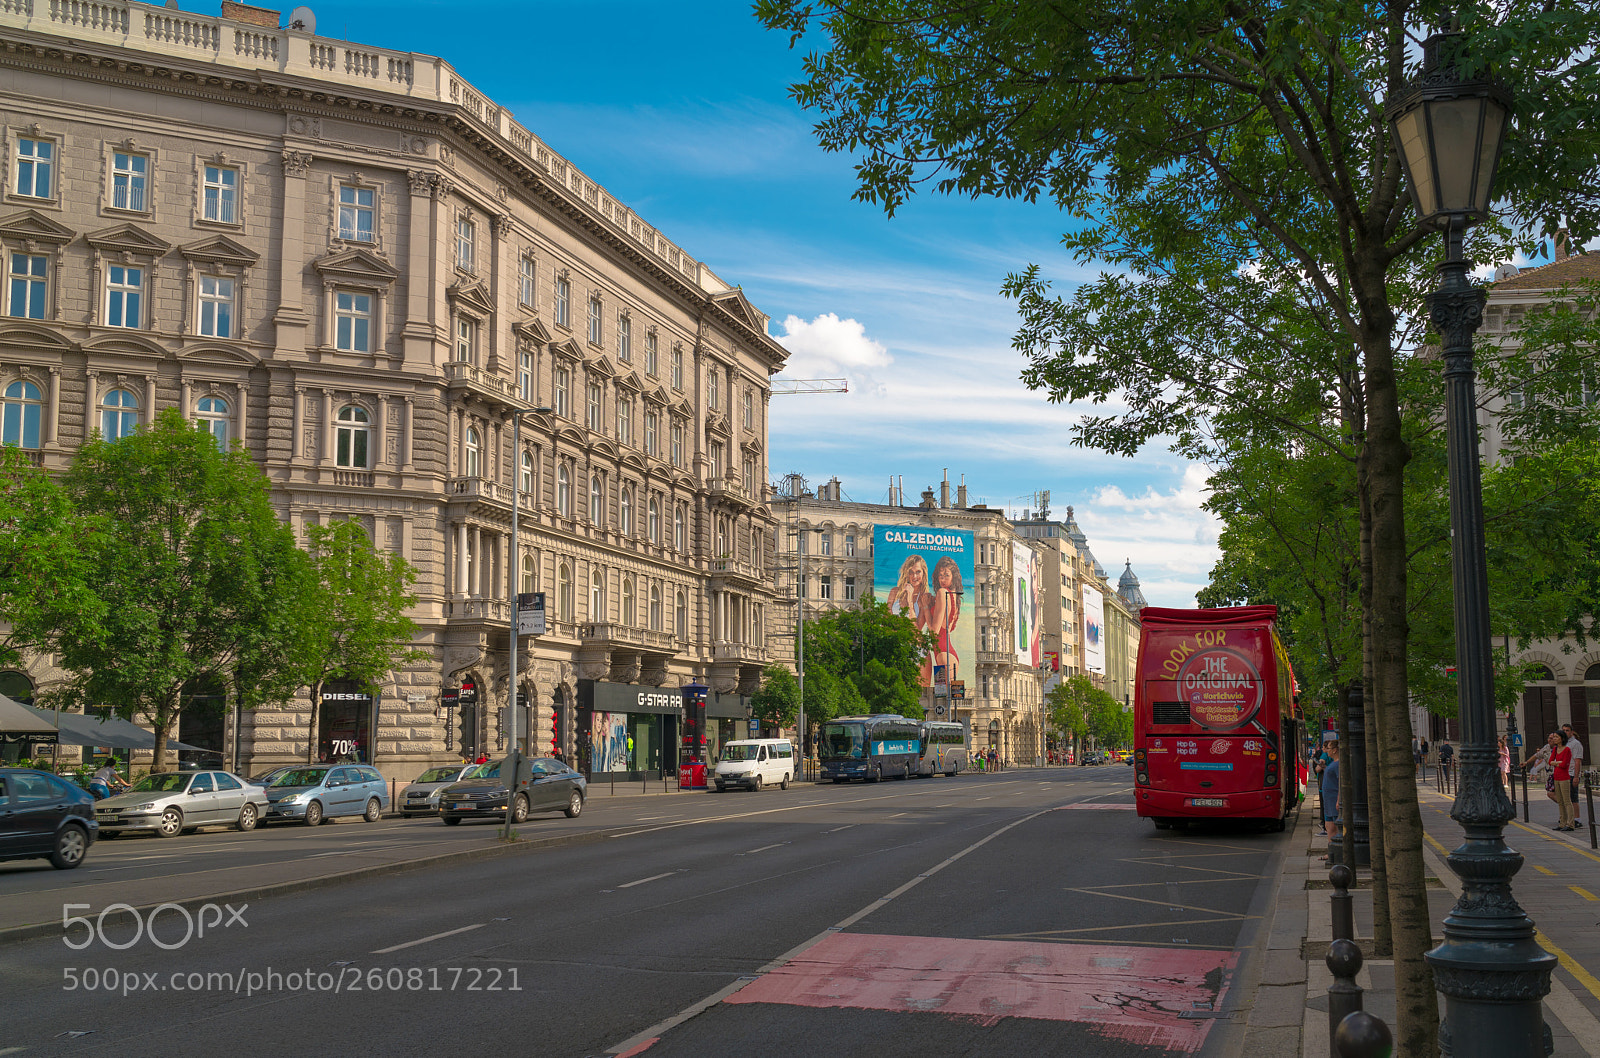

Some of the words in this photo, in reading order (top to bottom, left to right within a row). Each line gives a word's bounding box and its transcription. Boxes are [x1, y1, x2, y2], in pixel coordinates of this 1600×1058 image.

[885, 531, 964, 547] CALZEDONIA
[929, 545, 964, 553] BEACHWEAR
[1160, 640, 1195, 680] LOOK
[1195, 630, 1226, 649] FOR
[1203, 656, 1228, 673] THE
[1185, 672, 1254, 690] ORIGINAL
[323, 693, 371, 701] DIESEL
[670, 694, 682, 708] RA
[1176, 740, 1188, 748] Hop
[1176, 748, 1188, 756] Hop
